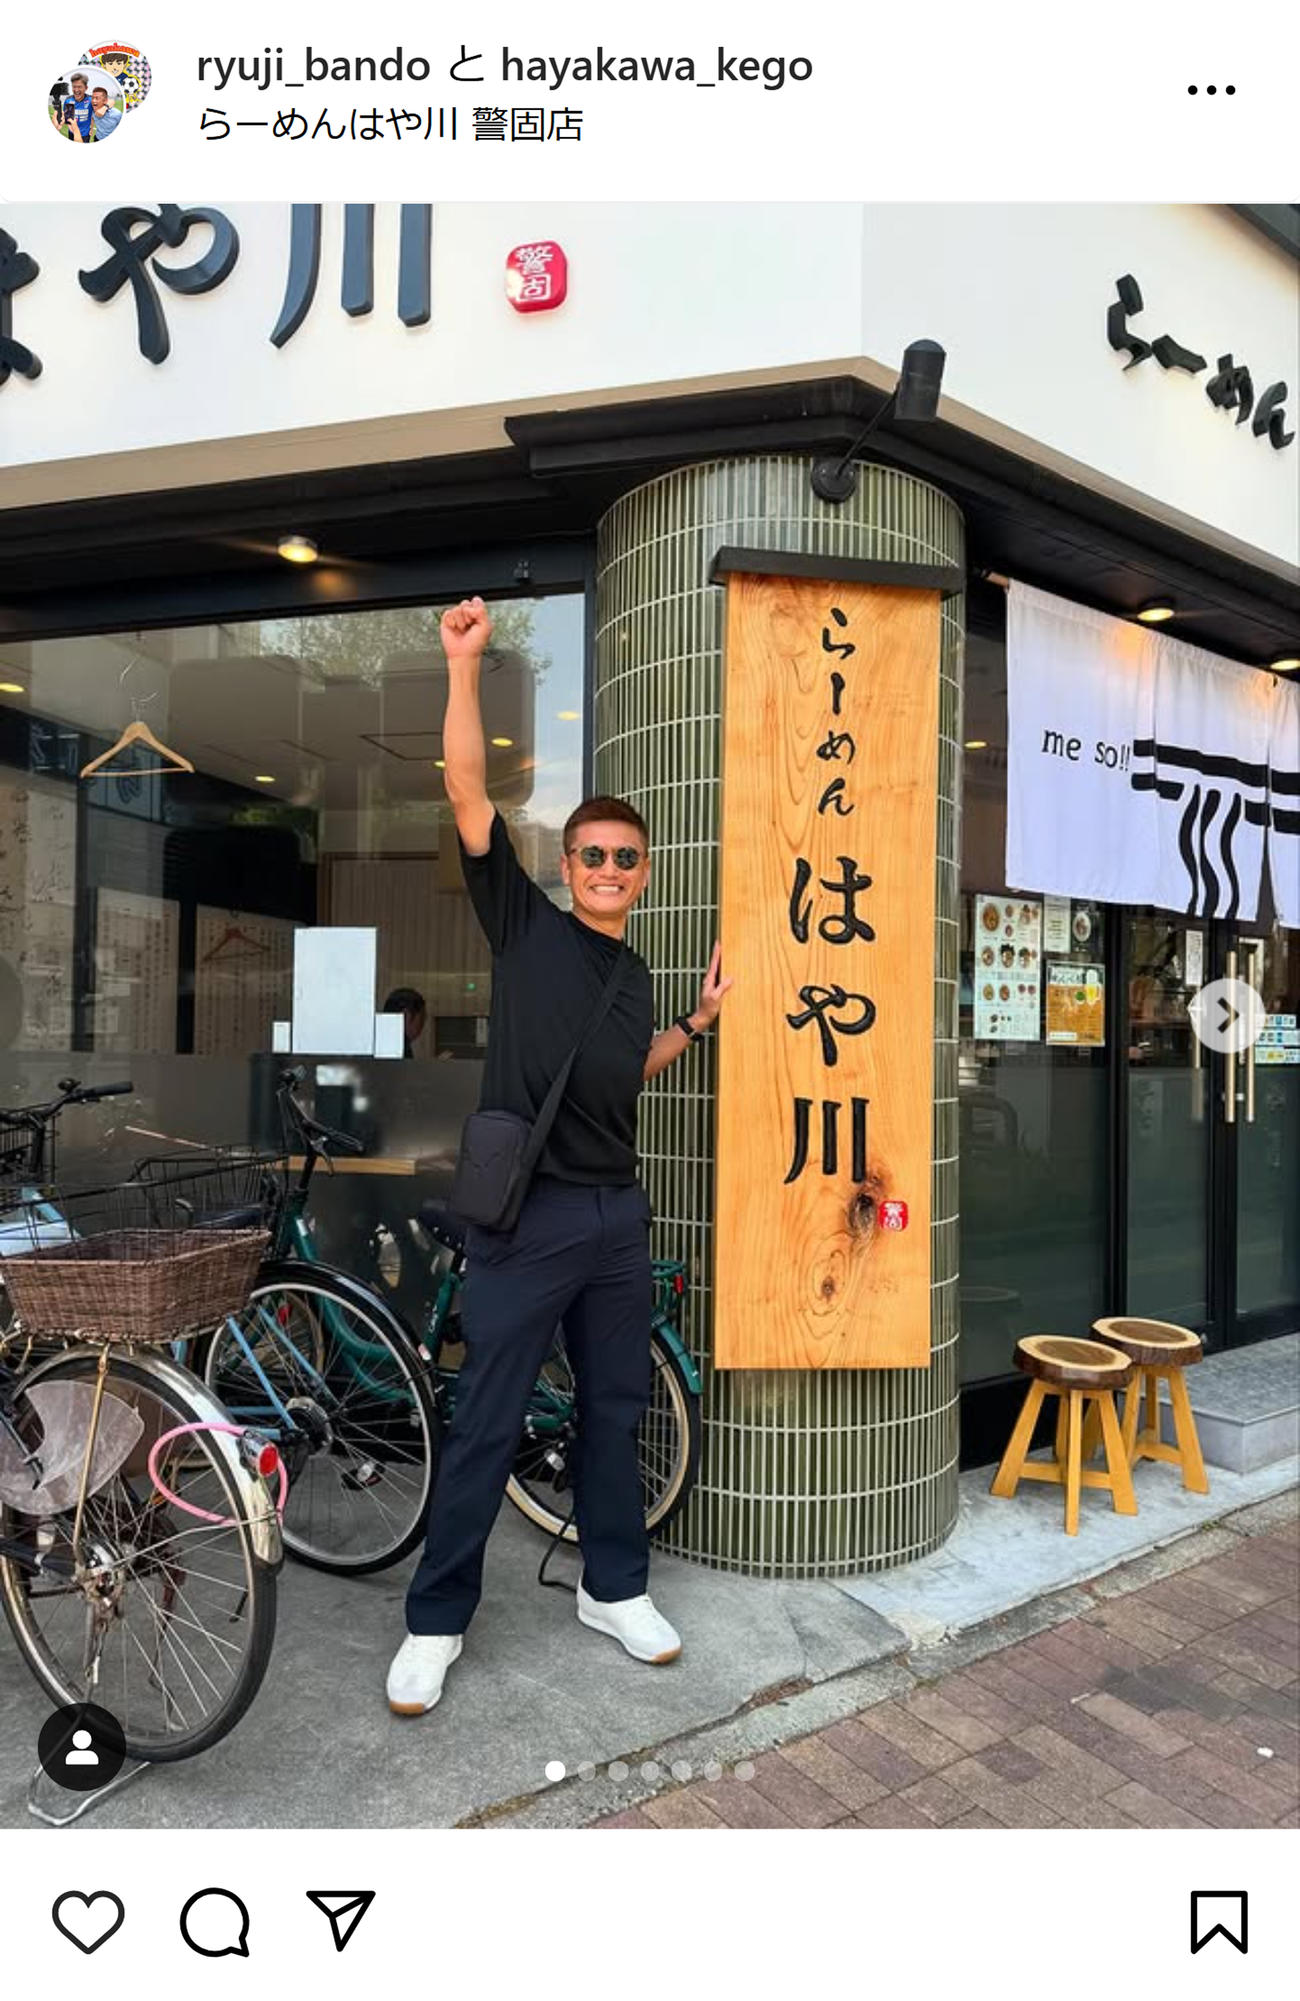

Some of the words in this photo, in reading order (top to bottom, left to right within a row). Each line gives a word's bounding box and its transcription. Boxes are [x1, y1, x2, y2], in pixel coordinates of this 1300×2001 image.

[1107, 273, 1296, 450] らーめん
[1042, 729, 1081, 761] me
[1094, 741, 1130, 772] so!!
